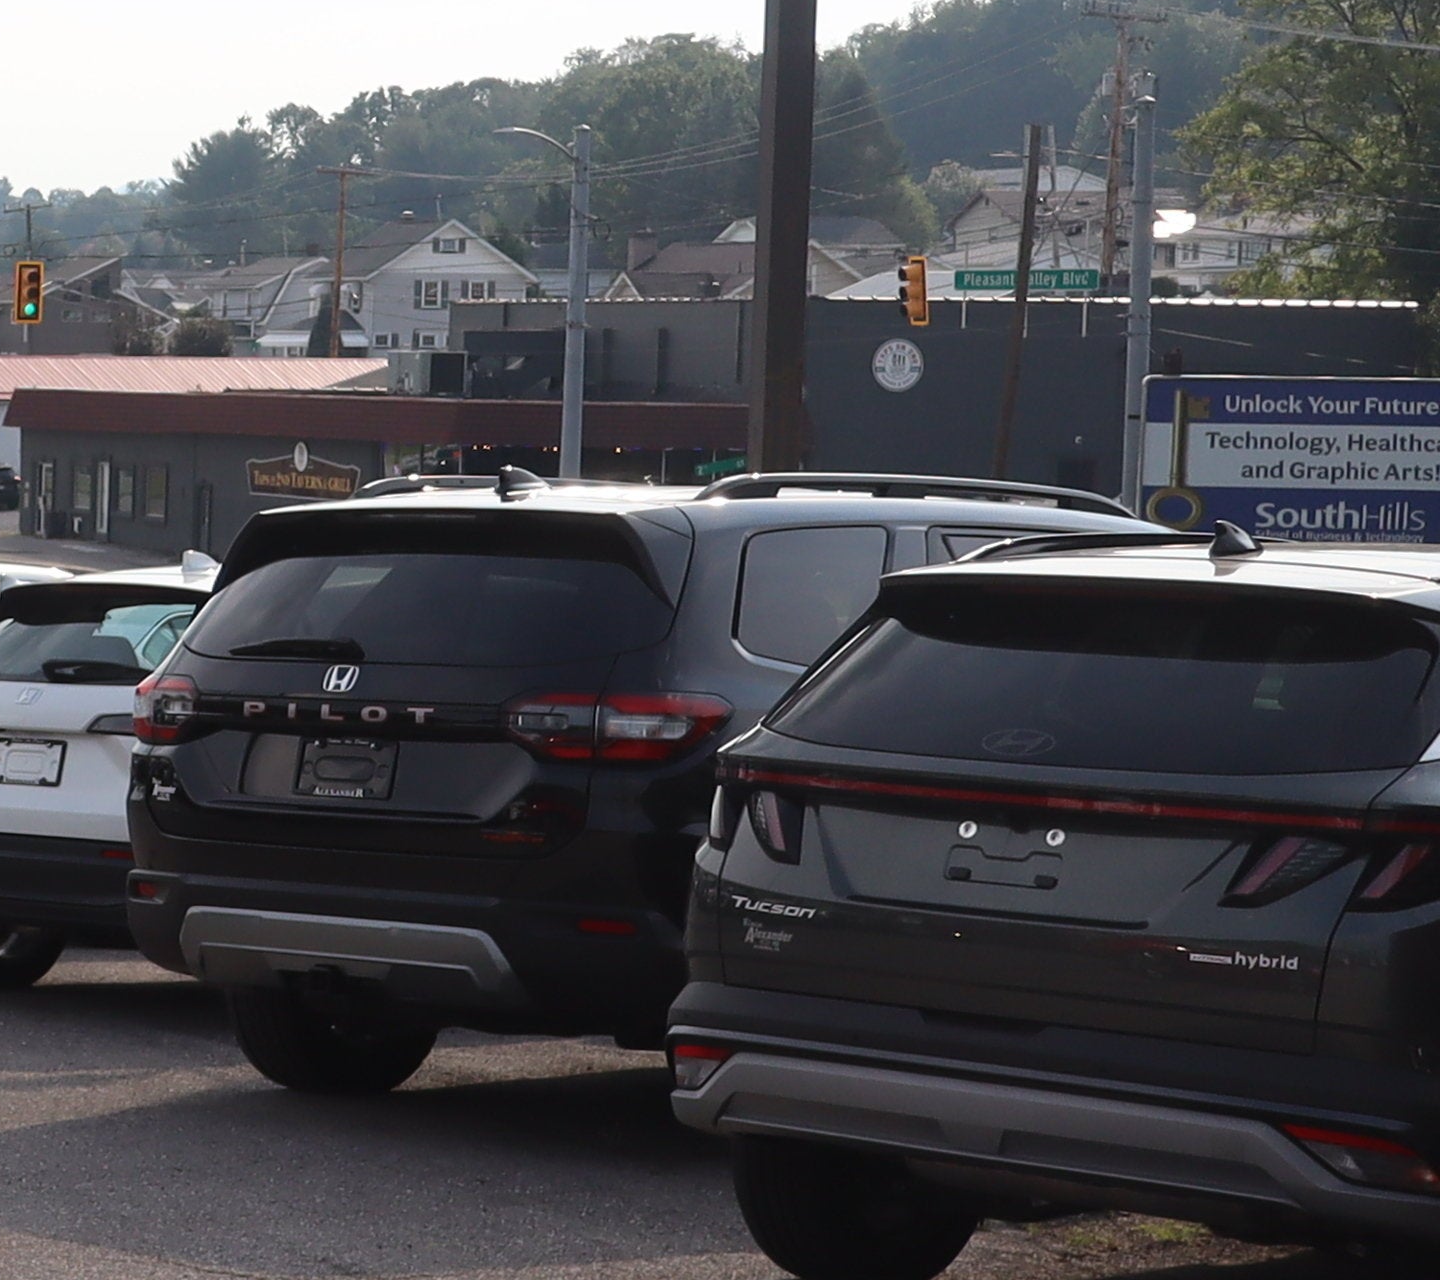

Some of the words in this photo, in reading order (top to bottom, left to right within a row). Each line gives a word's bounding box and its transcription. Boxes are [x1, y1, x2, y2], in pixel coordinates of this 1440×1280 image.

[963, 273, 1014, 287] Pleasant
[1028, 272, 1058, 288] alley
[1224, 393, 1302, 414] Unlock
[1308, 396, 1360, 415] Your
[1205, 431, 1341, 455] Technology,
[1241, 461, 1286, 479] and
[1290, 462, 1379, 484] Graphic
[1384, 463, 1440, 482] Arts!
[243, 701, 435, 724] PILOT
[313, 786, 365, 798] ALEXANDER
[1234, 951, 1299, 970] hybrid
